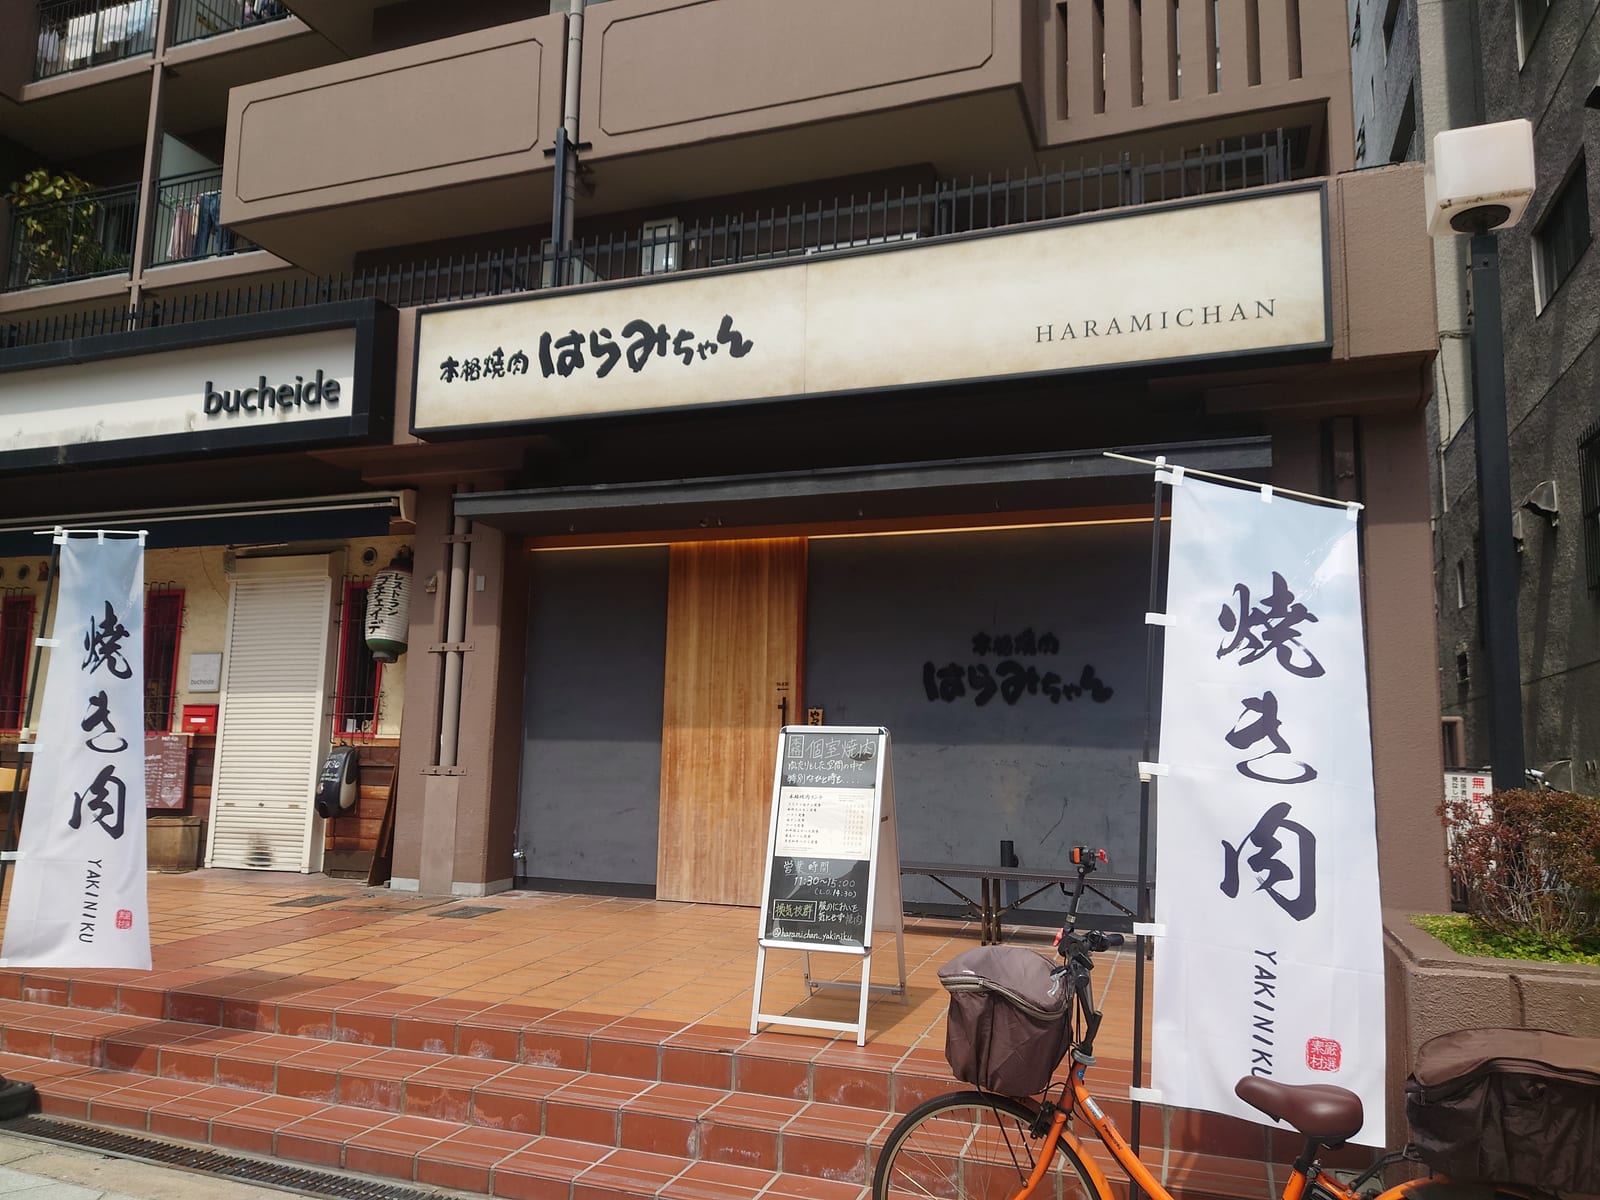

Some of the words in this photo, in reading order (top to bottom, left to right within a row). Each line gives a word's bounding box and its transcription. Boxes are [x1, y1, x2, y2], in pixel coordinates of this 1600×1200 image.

[1035, 297, 1279, 344] HARAMICHAN
[439, 347, 530, 385] 本格焼肉
[538, 314, 755, 380] はらみちゃん
[203, 368, 341, 417] bucheide
[387, 572, 404, 616] レストラン
[923, 660, 1114, 707] はらみちゃん
[68, 600, 133, 840] 焼き肉
[807, 737, 877, 760] 個室焼肉
[1216, 570, 1327, 922] 焼き肉
[78, 858, 103, 944] YAKINIKU
